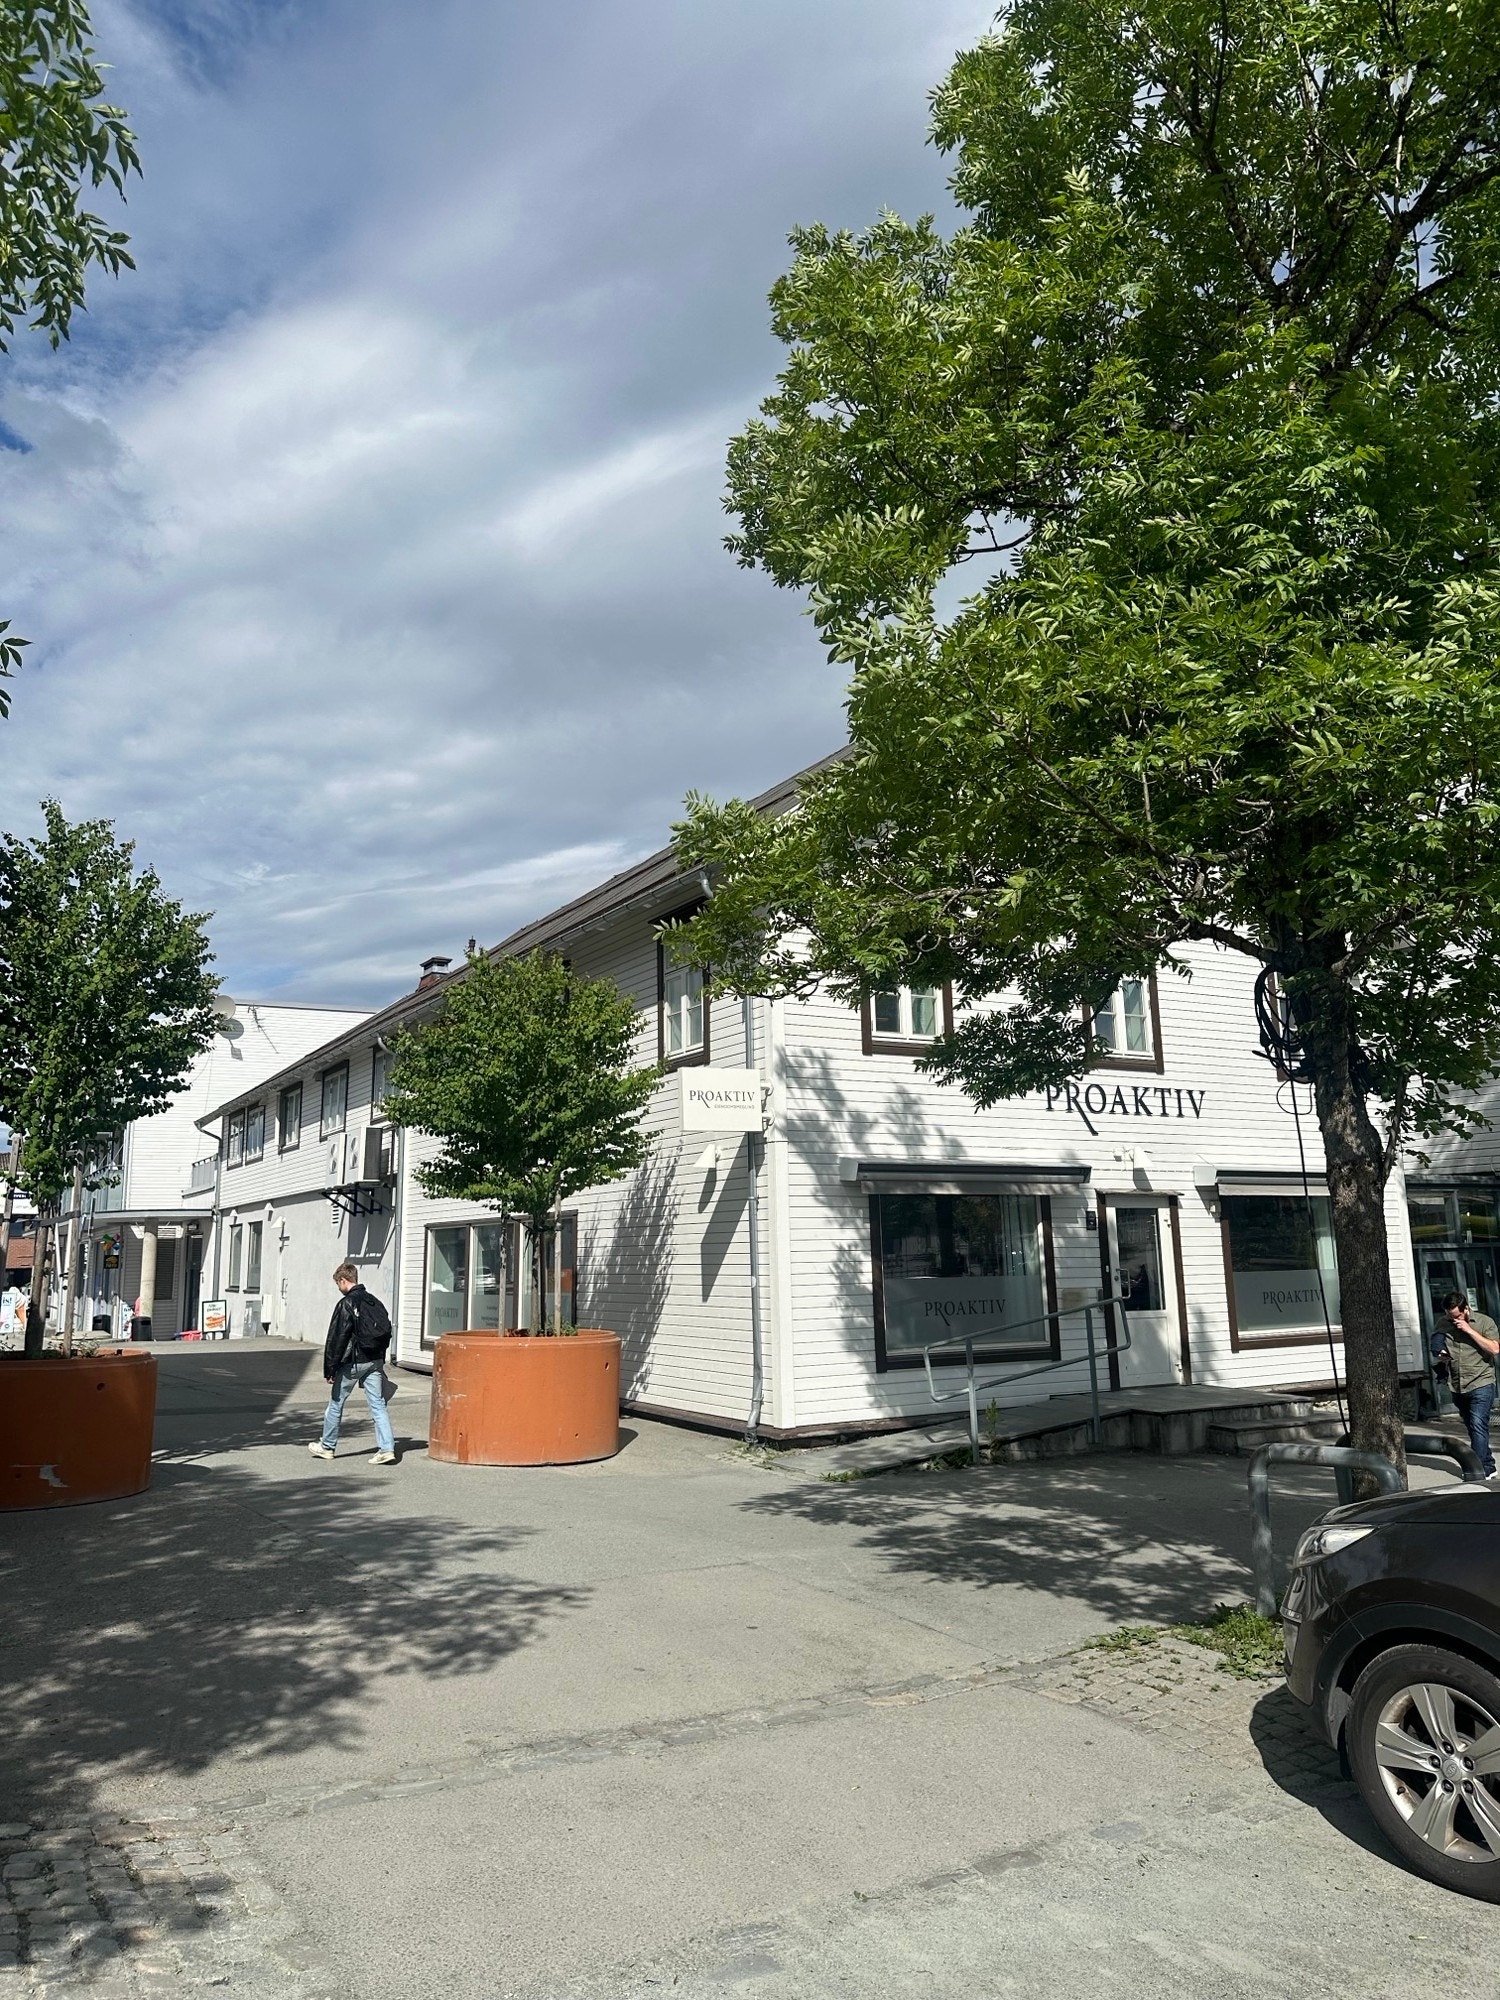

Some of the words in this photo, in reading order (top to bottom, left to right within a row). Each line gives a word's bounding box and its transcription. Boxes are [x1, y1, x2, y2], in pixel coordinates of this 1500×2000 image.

[689, 1090, 755, 1108] PROAKTIV
[1046, 1083, 1205, 1136] PROAKTIV
[925, 1299, 1005, 1326] PROAKTIV
